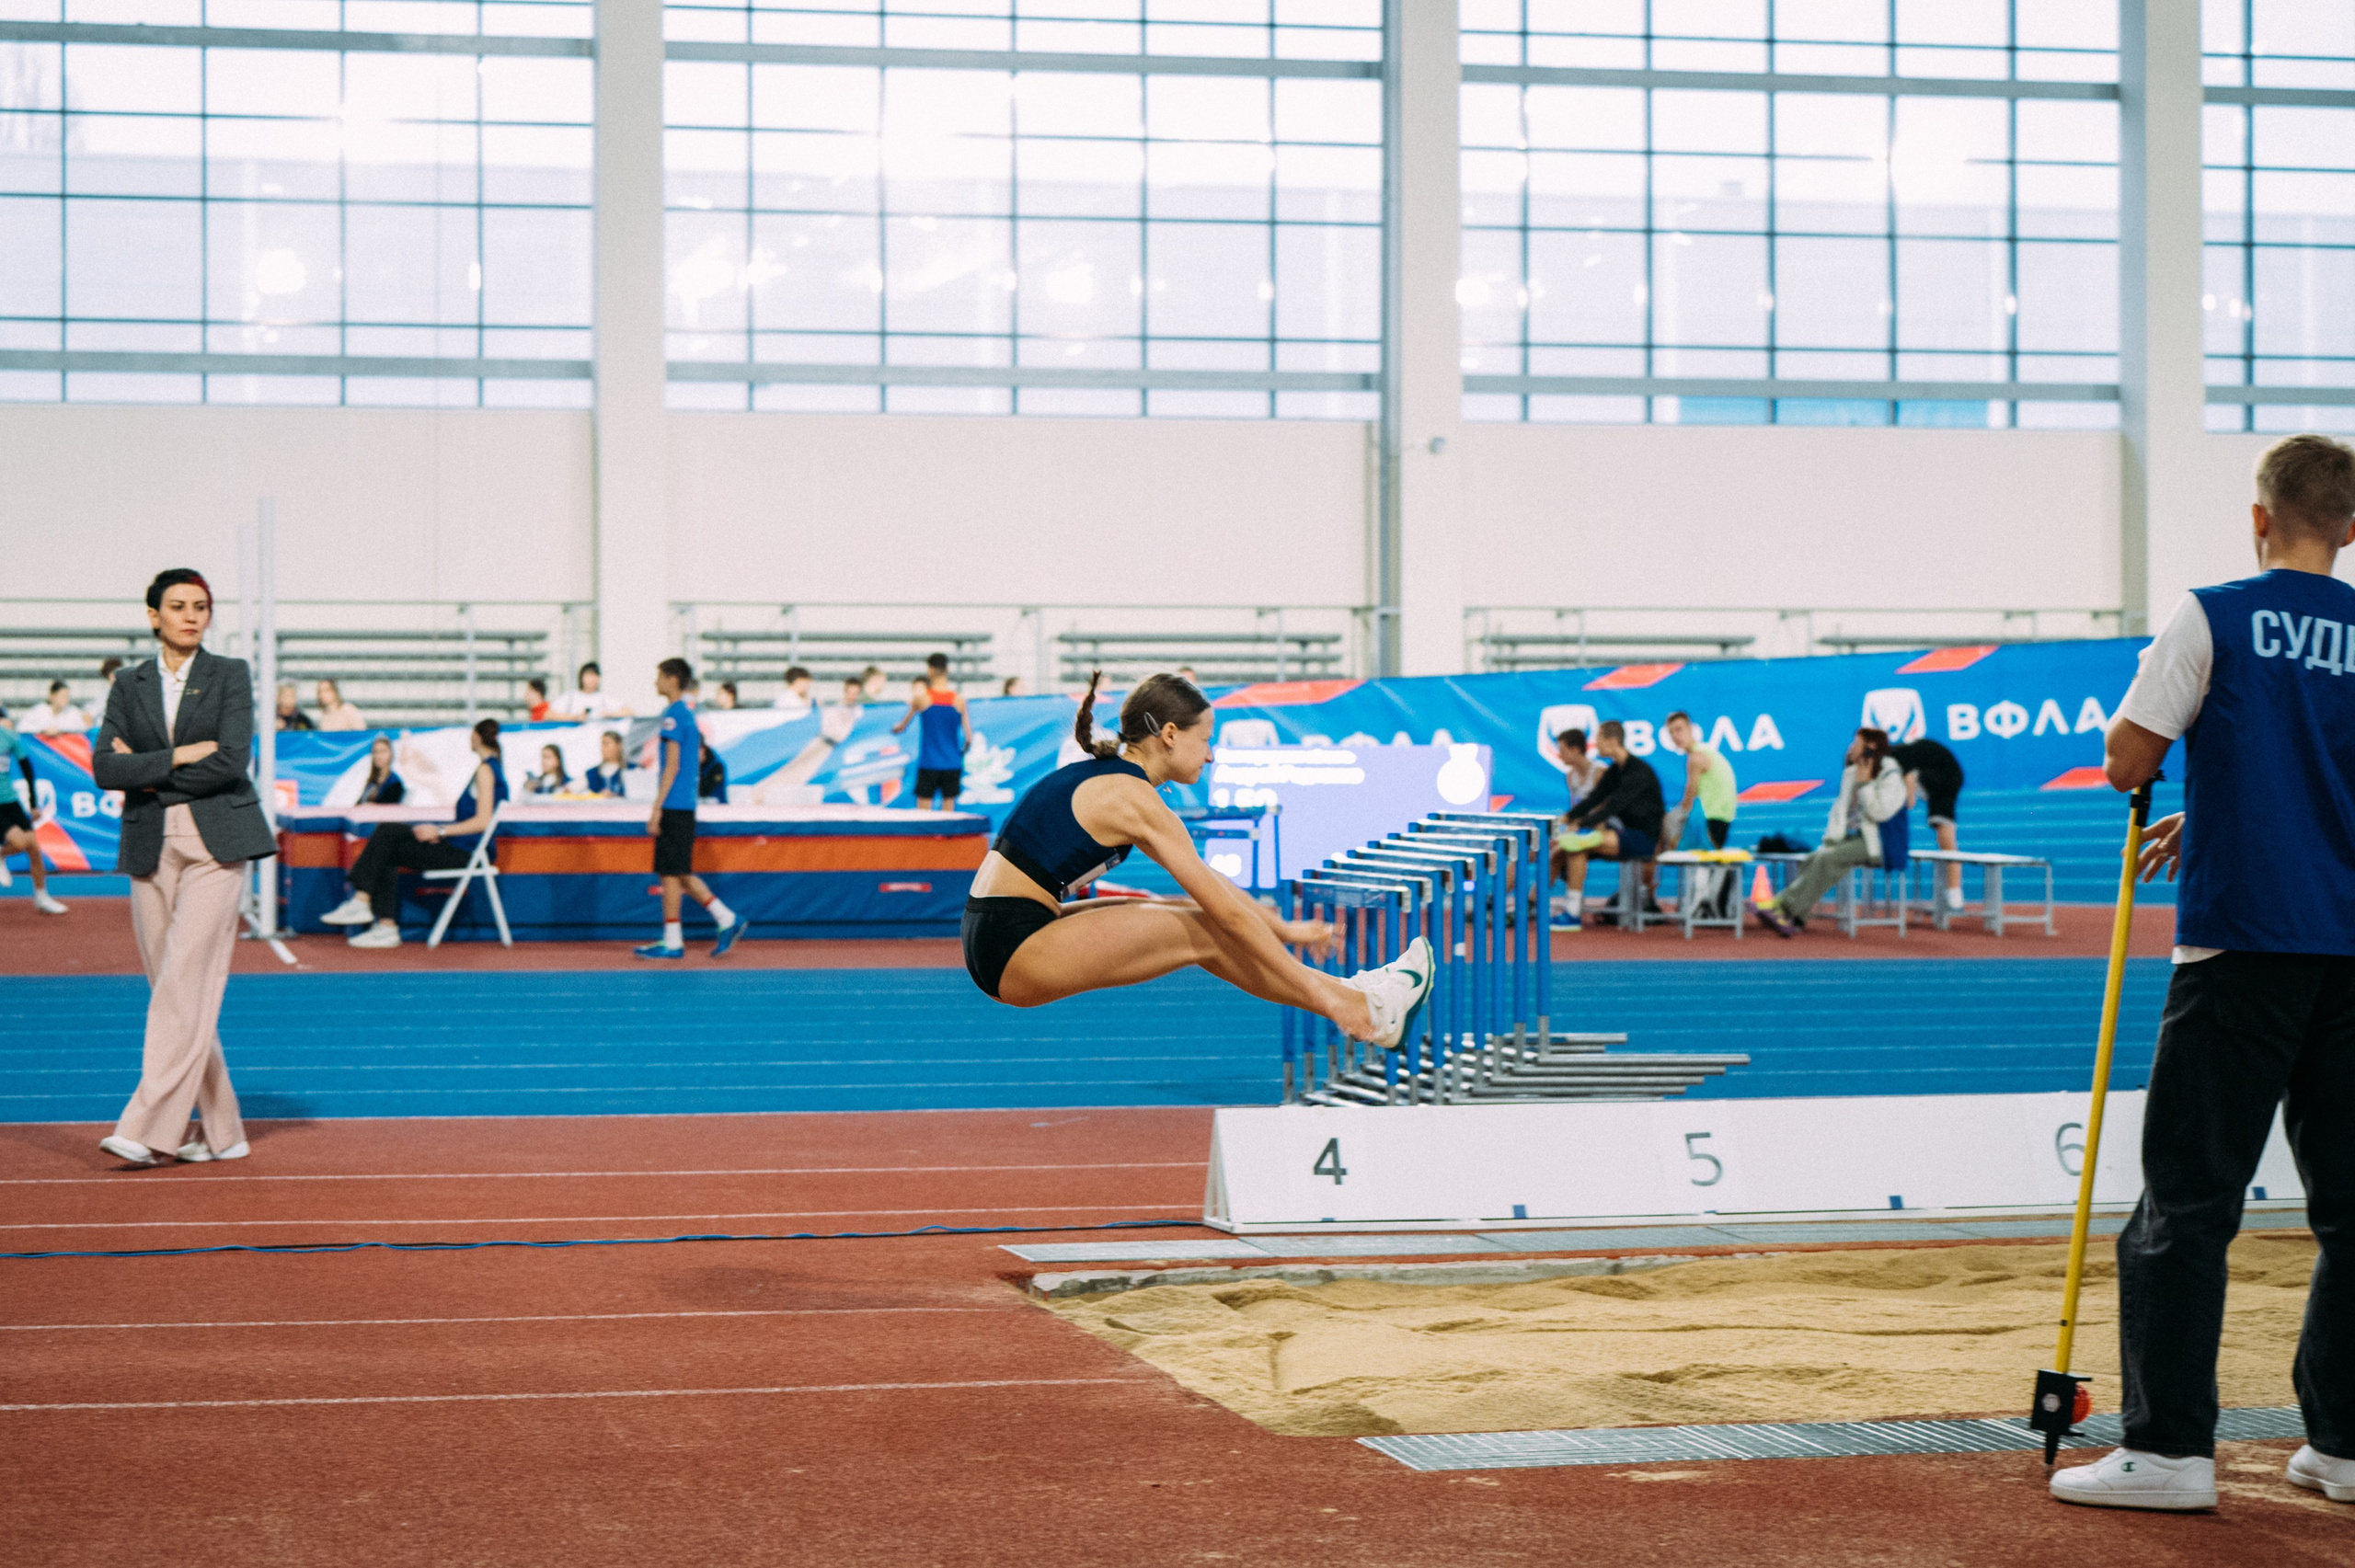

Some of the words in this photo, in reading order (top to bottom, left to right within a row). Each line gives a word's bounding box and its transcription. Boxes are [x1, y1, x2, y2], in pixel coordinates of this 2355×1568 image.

[1947, 696, 2110, 740] ВФЛА
[1313, 1137, 1348, 1185] 4
[1684, 1131, 1723, 1186] 5
[2055, 1122, 2086, 1177] 6
